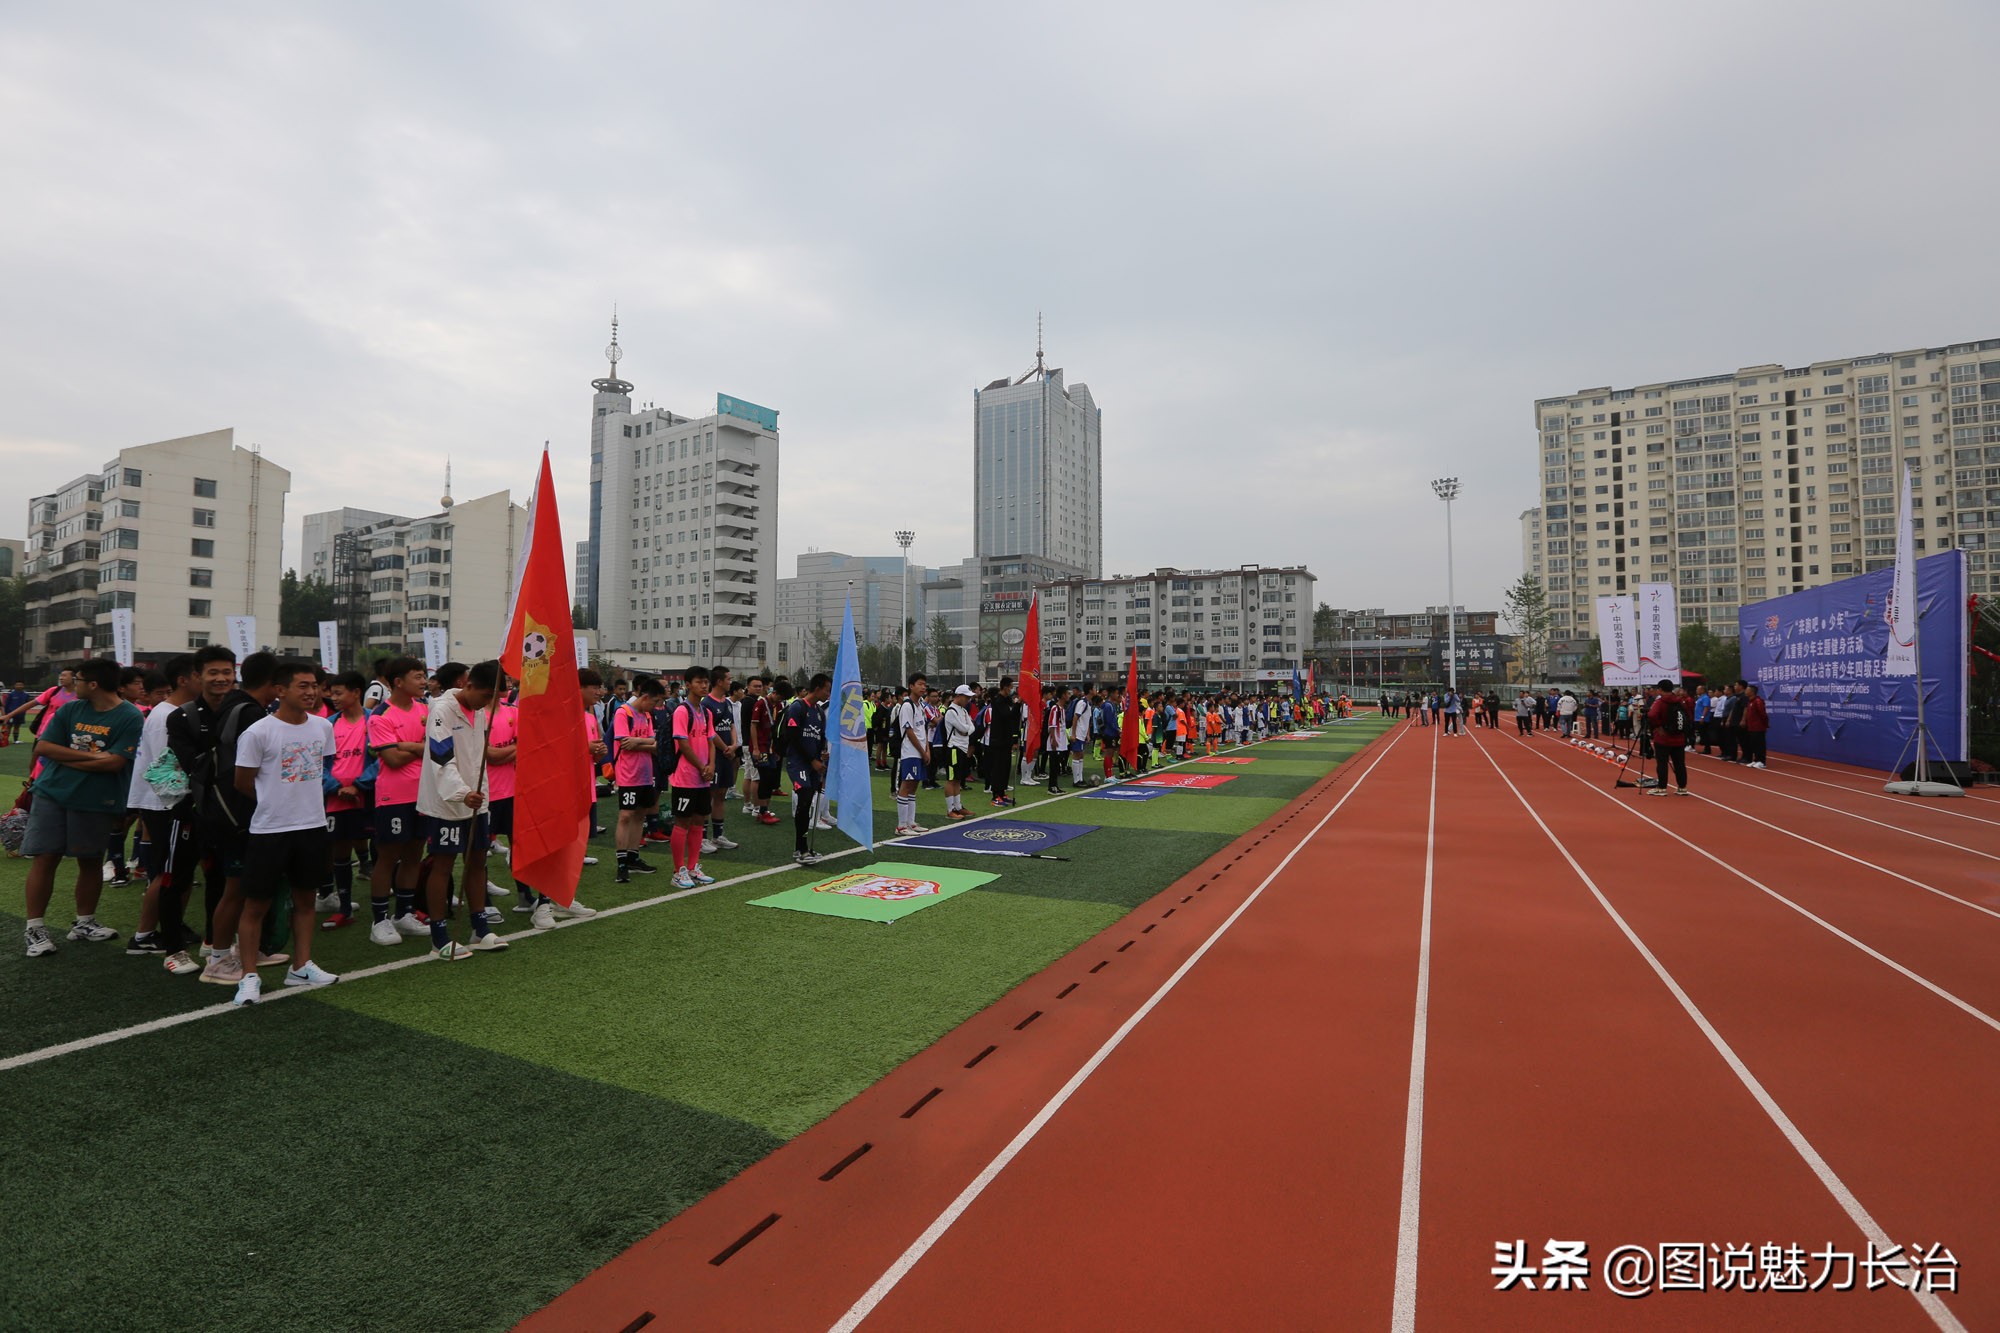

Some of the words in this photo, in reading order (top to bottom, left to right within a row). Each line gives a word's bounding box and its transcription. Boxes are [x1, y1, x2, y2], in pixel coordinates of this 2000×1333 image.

[800, 771, 806, 781] 4
[622, 792, 636, 806] 35
[677, 797, 690, 812] 17
[391, 817, 401, 834] 9
[440, 826, 460, 846] 24
